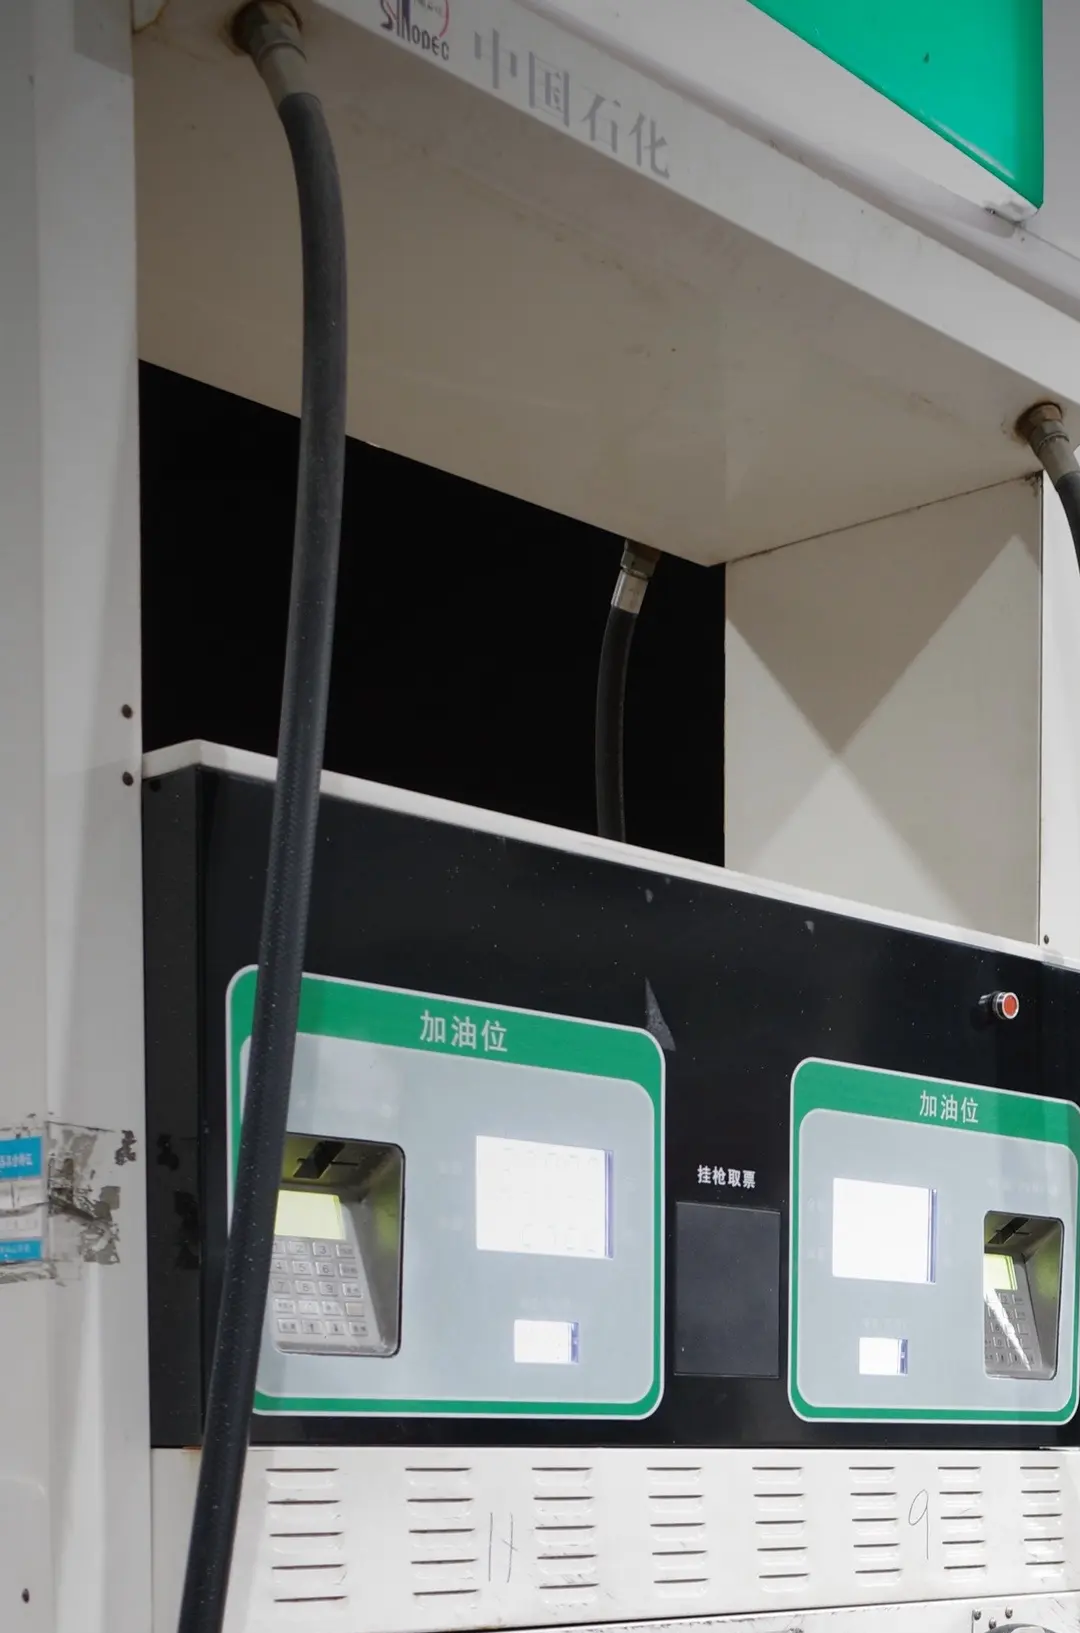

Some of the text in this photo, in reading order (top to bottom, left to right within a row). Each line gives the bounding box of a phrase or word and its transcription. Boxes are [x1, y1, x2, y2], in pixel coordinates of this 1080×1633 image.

[473, 27, 671, 181] 中国石化
[419, 1009, 509, 1053] 加油位
[919, 1089, 979, 1124] 加油位
[697, 1164, 756, 1189] 挂枪取票
